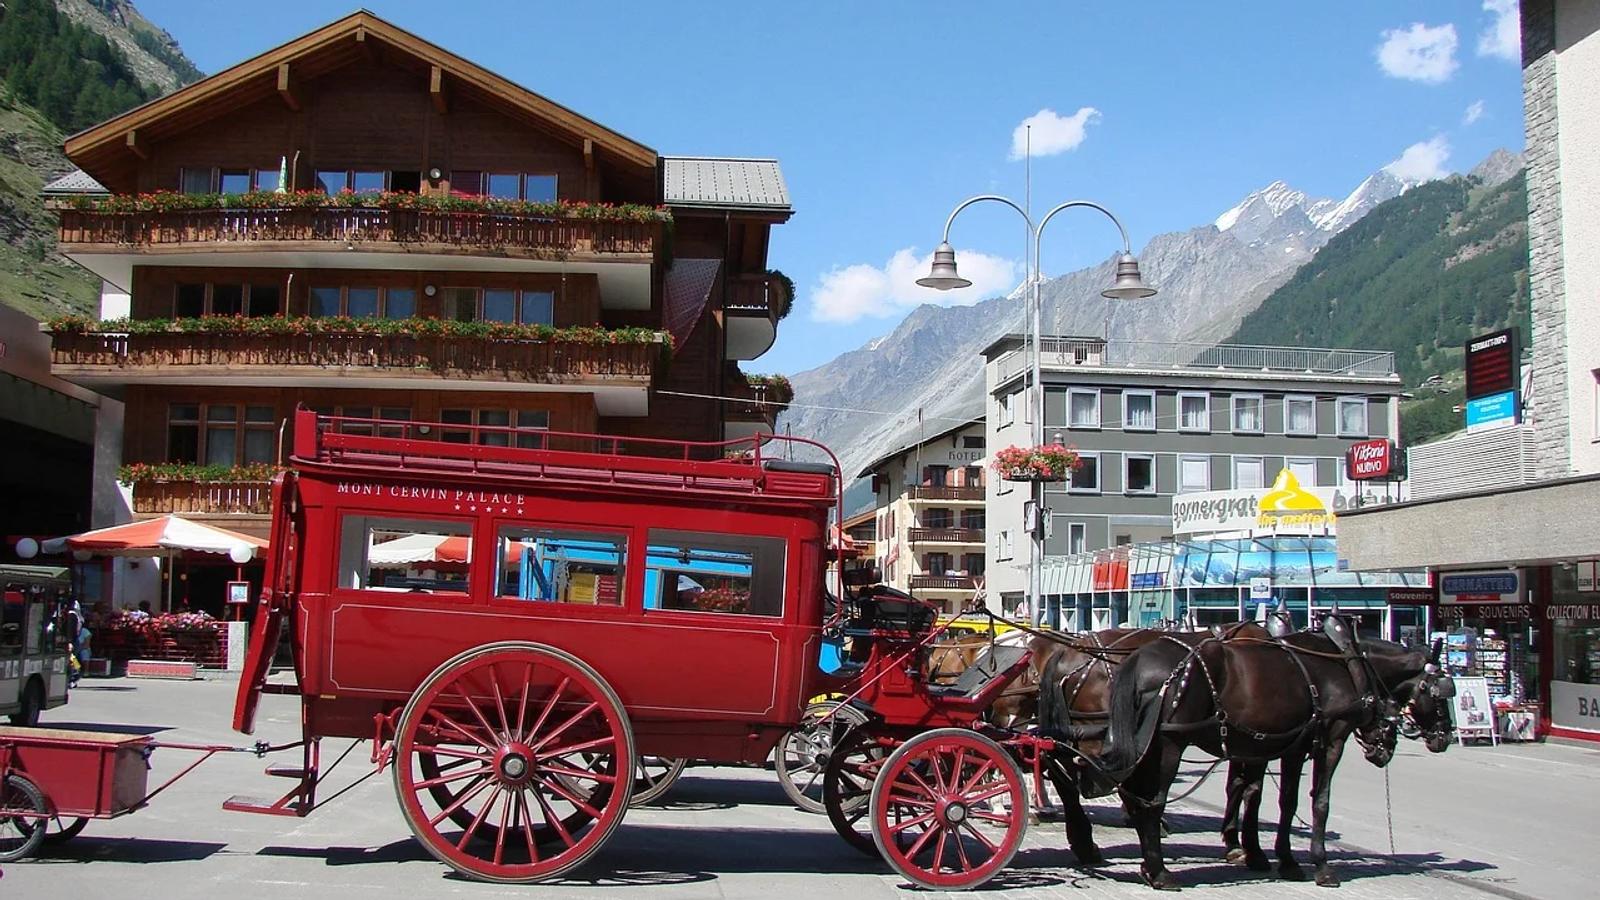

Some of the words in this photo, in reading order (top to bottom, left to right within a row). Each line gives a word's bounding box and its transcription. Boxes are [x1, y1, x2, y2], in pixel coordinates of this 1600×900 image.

[337, 482, 383, 495] MONT
[390, 485, 448, 500] CERVIN
[455, 490, 525, 505] PALACE
[1173, 494, 1257, 523] gornergrat
[1390, 591, 1434, 600] souvenirs
[1438, 606, 1464, 618] SWISS
[1478, 604, 1530, 619] SOUVENIRS
[1546, 604, 1589, 620] COLLECTION
[1578, 696, 1600, 717] BA
